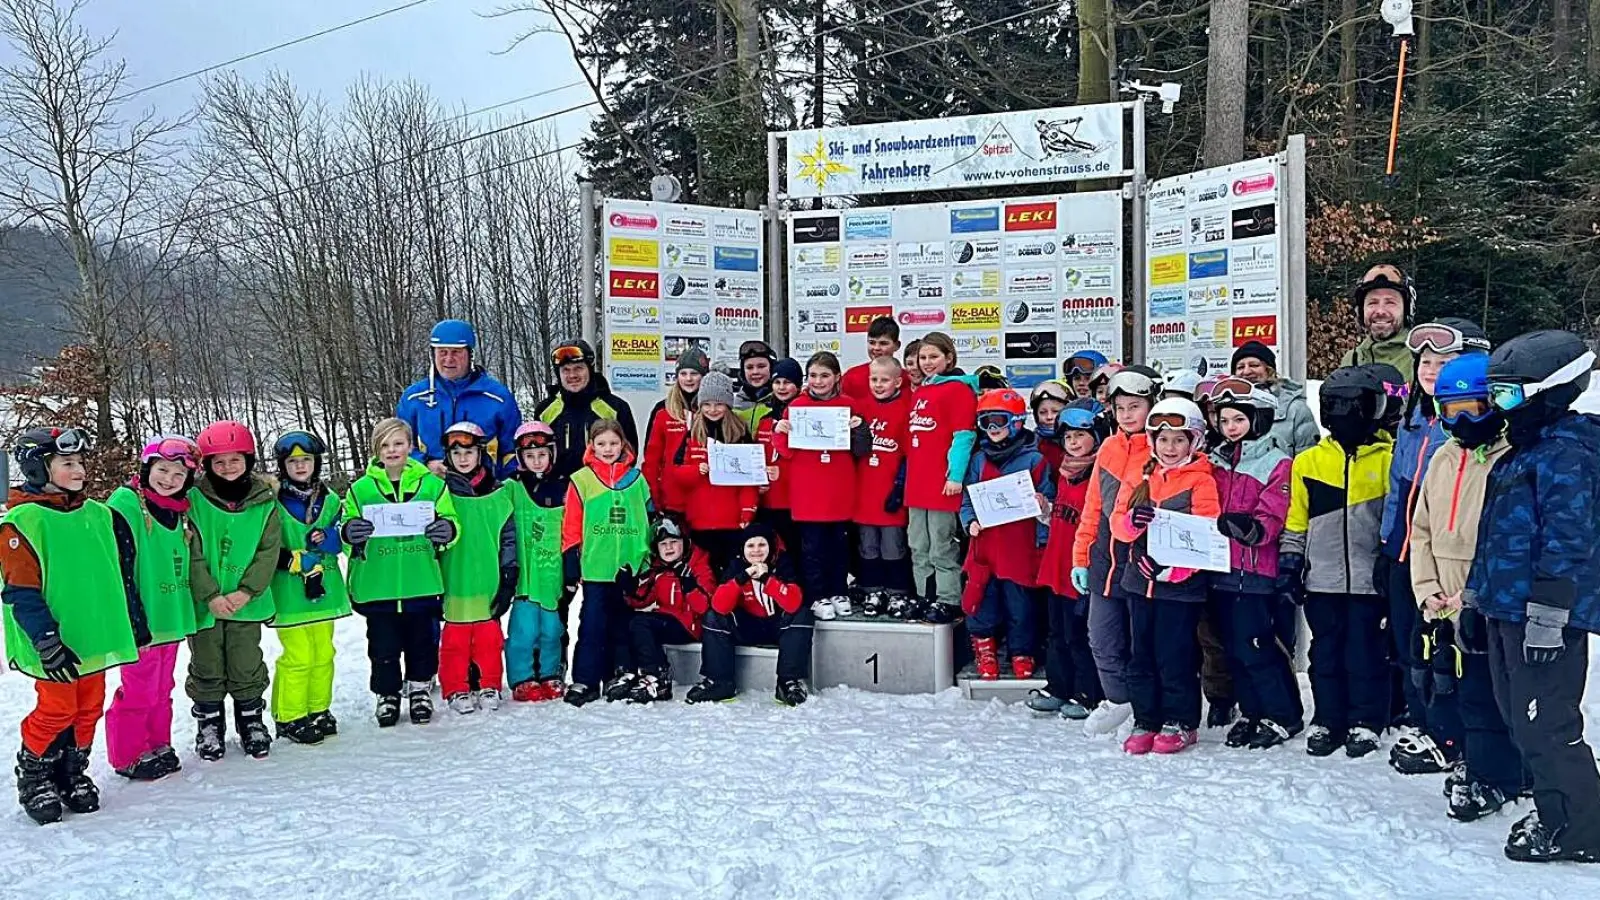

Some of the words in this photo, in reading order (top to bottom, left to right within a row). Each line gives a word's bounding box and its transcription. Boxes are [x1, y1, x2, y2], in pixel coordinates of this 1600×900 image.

[828, 141, 849, 156] Ski-
[852, 140, 871, 154] und
[875, 134, 976, 153] Snowboardzentrum
[983, 143, 1013, 157] Spitze!
[861, 160, 931, 180] Fahrenberg
[963, 161, 1111, 182] www.tv-vohenstrauss.de
[1007, 210, 1054, 223] LEKI
[612, 278, 657, 291] LEKI
[1062, 297, 1114, 309] AMANN
[715, 306, 759, 318] AMANN
[952, 307, 999, 317] Kfz-BALK
[1150, 321, 1185, 334] AMANN
[1234, 324, 1274, 338] LEKI
[612, 339, 659, 349] Kfz-BALK
[869, 417, 888, 431] 1st
[592, 524, 639, 536] Sparkasse
[865, 653, 878, 684] 1
